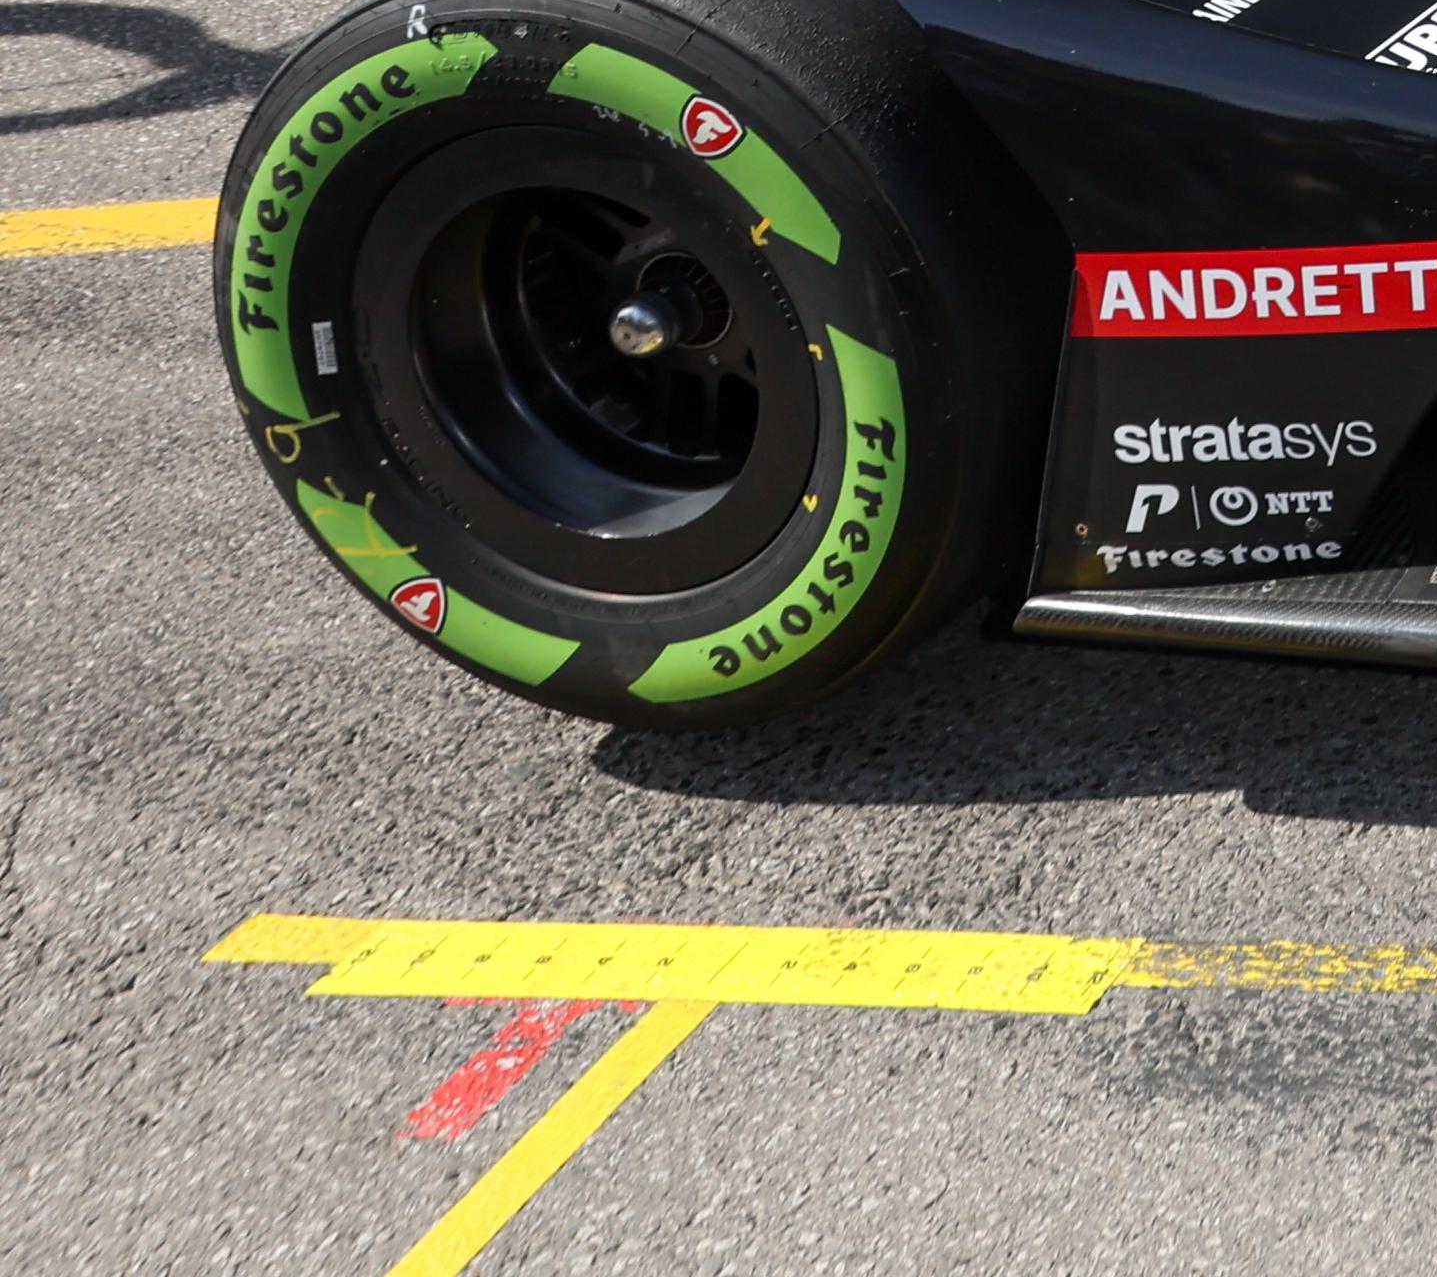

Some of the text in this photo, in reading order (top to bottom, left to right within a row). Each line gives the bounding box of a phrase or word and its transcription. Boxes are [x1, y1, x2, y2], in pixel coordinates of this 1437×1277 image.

[239, 59, 416, 336] Firestone
[1113, 416, 1377, 466] stratasys
[1265, 490, 1334, 516] NTT
[709, 416, 897, 679] Firestone
[1096, 539, 1342, 574] Firestone
